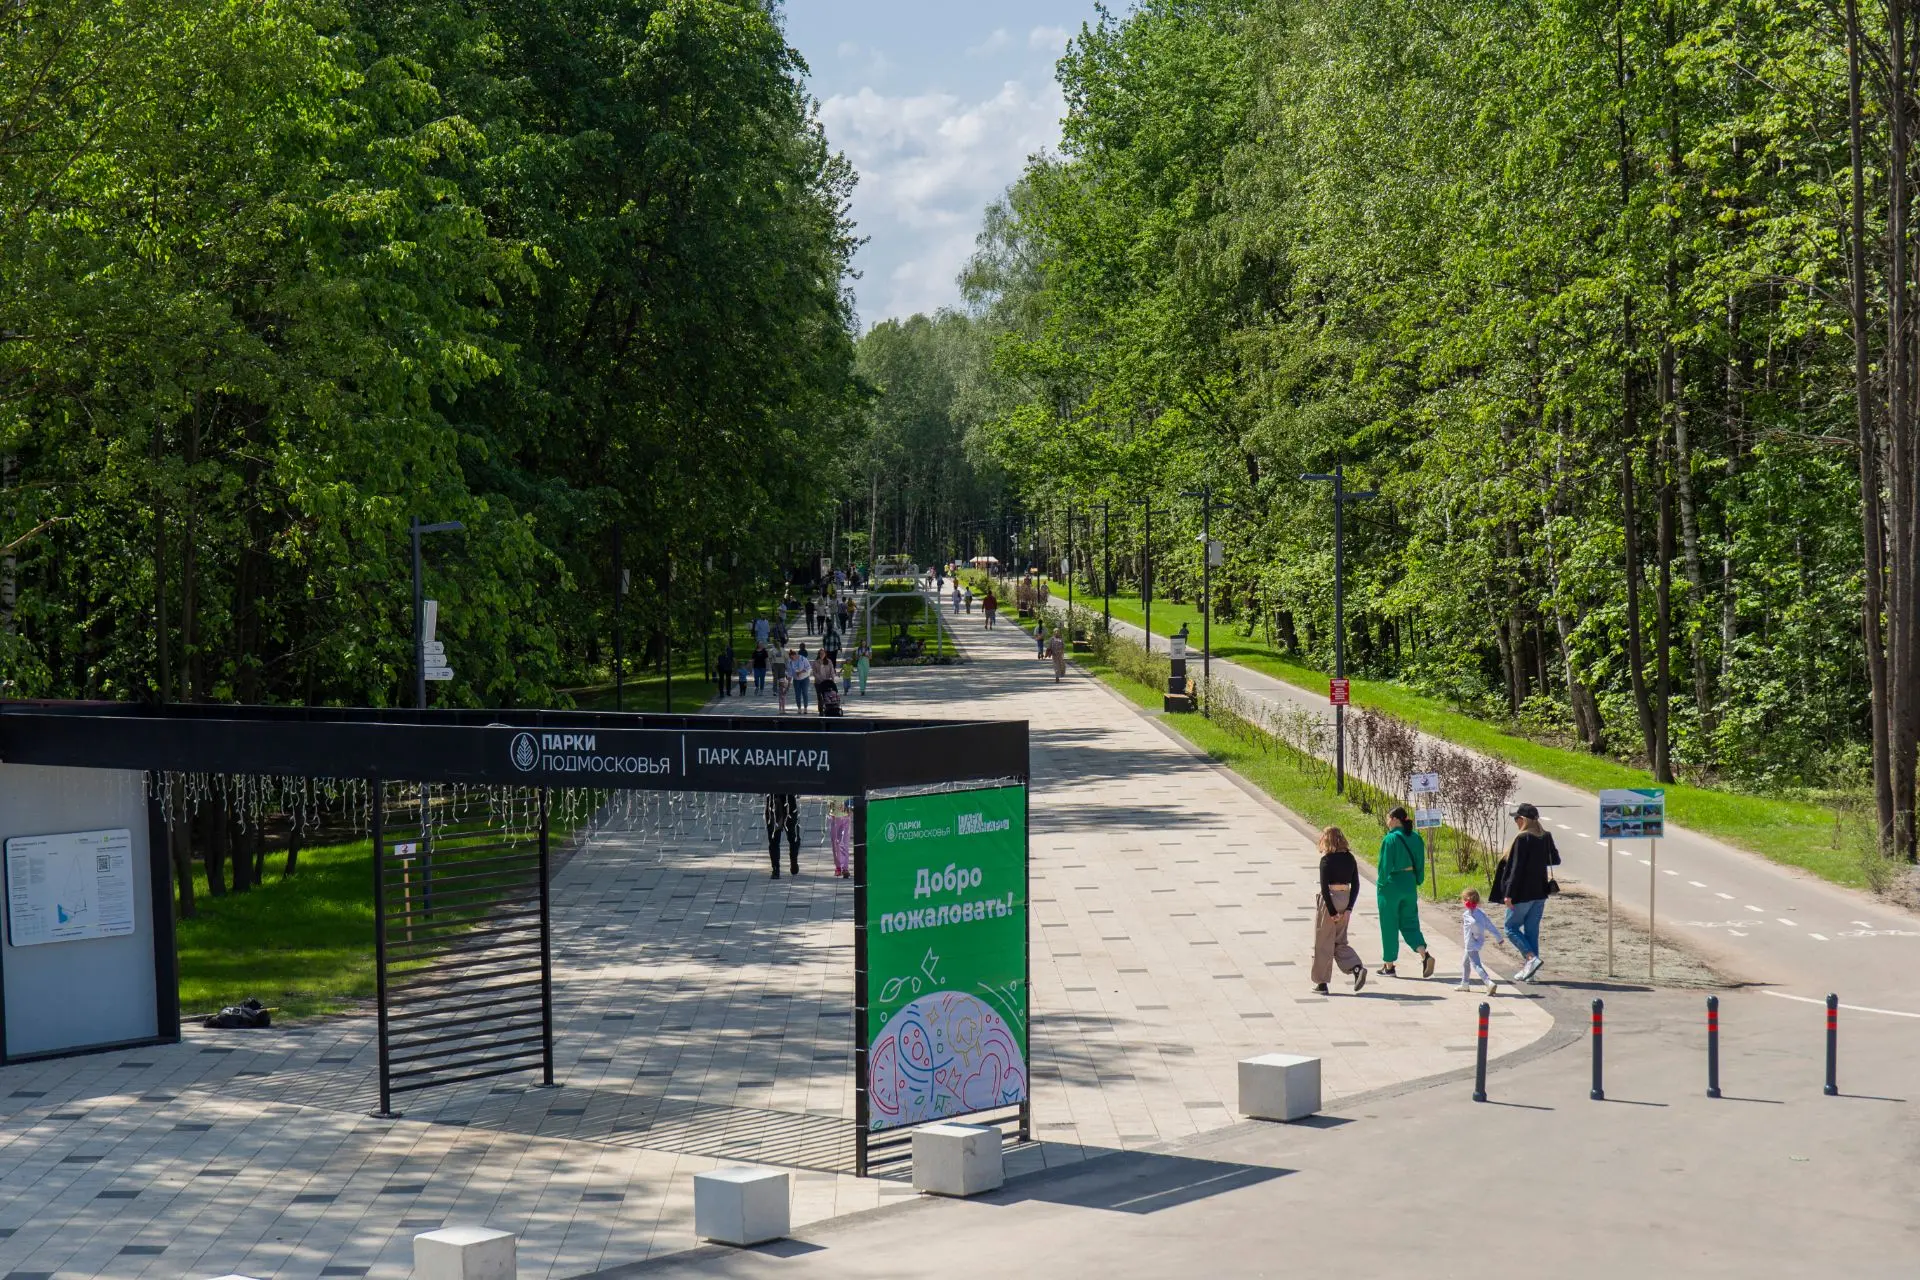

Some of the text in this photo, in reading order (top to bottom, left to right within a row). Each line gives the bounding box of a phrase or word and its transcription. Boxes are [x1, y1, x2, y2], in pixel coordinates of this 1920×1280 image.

[542, 735, 596, 750] ПАРКИ
[542, 755, 670, 774] ПОДМОСКОВЬЯ
[698, 747, 830, 771] ПАРК АВАНГАРД
[898, 820, 921, 830] ПАРКИ
[914, 863, 982, 899] Добро
[880, 892, 1013, 933] пожаловать!
